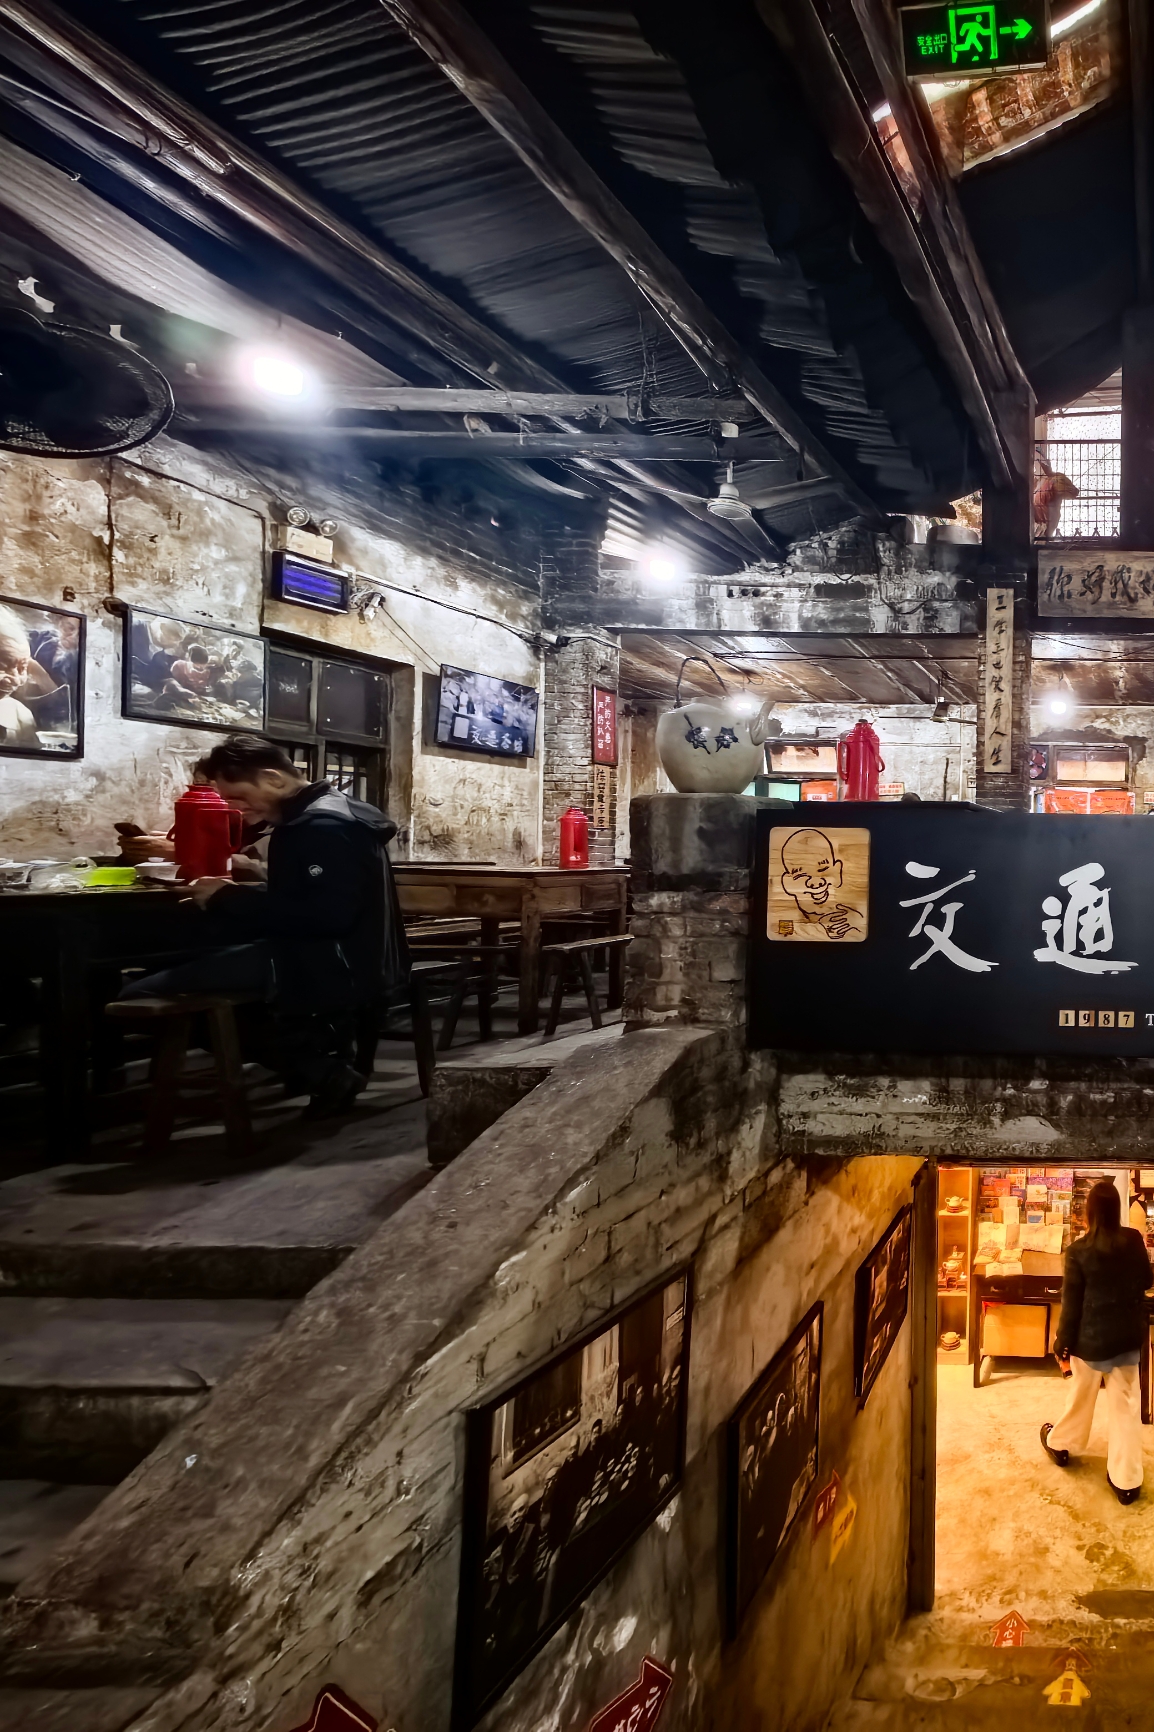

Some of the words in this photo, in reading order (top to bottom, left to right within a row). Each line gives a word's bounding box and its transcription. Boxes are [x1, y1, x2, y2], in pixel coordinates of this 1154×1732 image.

[916, 33, 948, 47] 安全出口
[921, 44, 945, 55] EXIT
[1060, 1011, 1134, 1028] 1987
